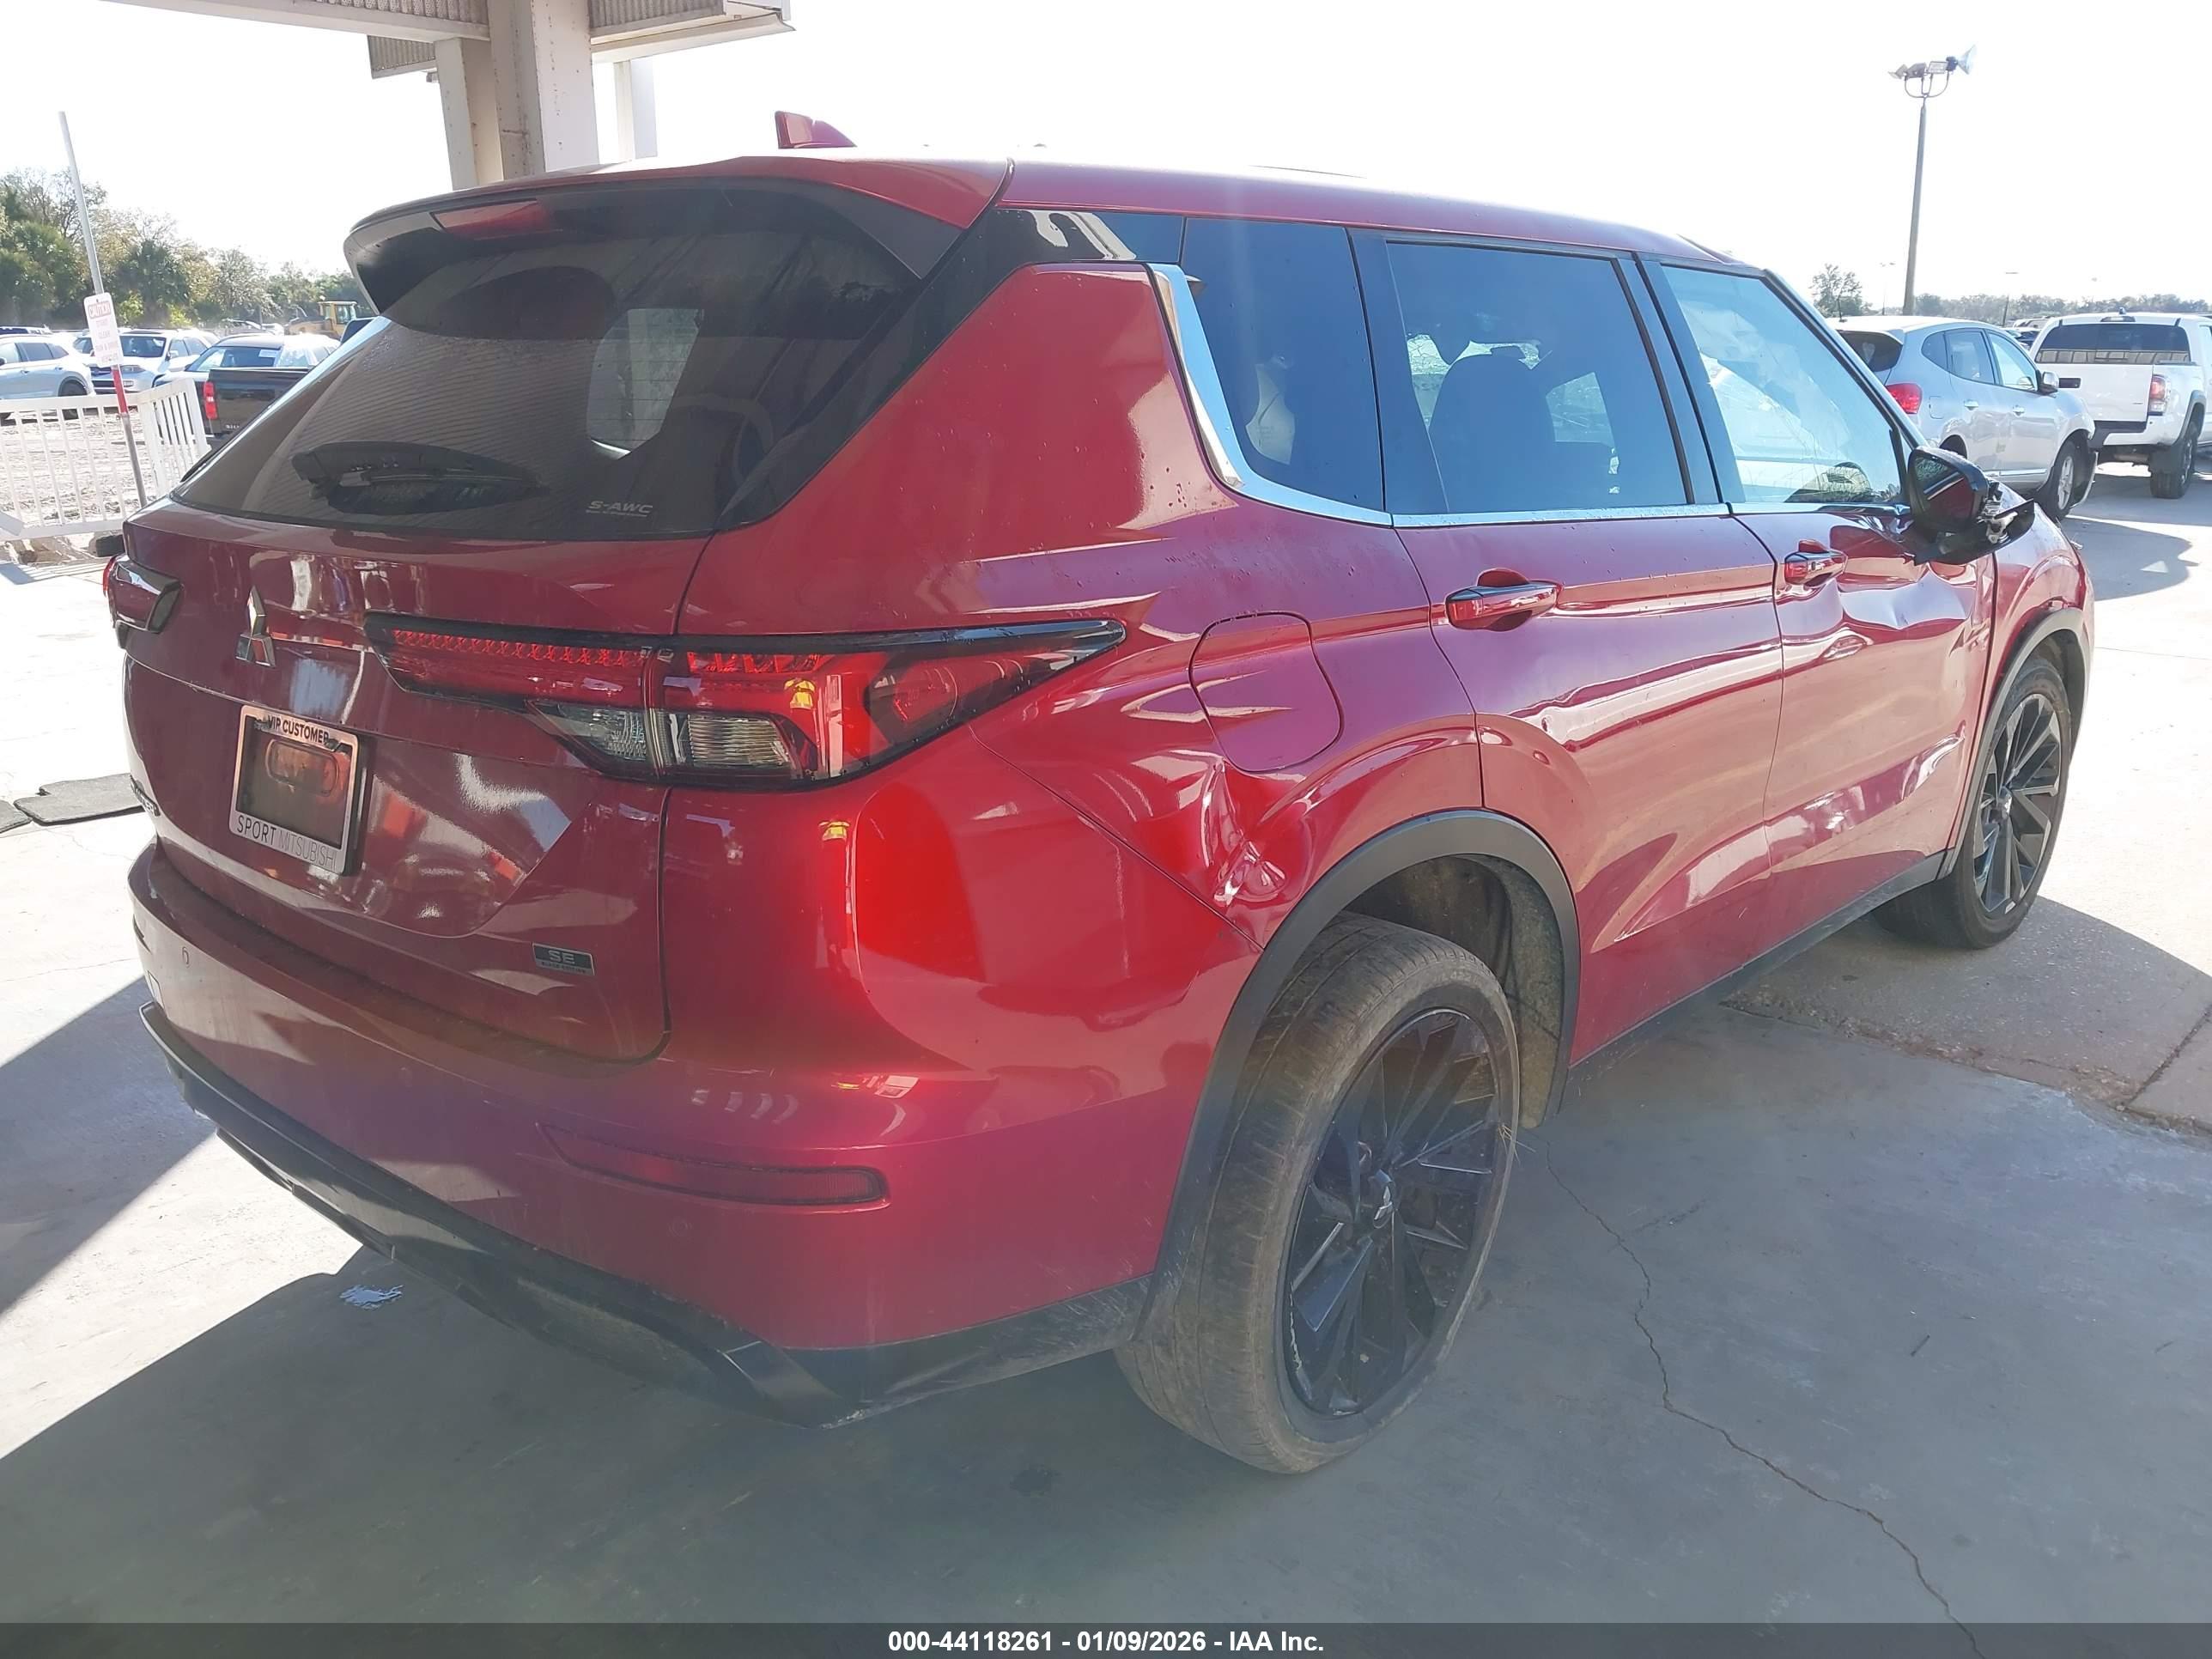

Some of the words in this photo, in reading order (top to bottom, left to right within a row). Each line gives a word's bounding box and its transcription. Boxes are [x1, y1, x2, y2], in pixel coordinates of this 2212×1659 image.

[89, 302, 110, 318] CAUTION
[588, 501, 653, 514] S-AWC
[267, 714, 282, 731] VIP
[282, 720, 330, 744] CUSTOMER
[236, 814, 276, 846] SPORT
[279, 830, 337, 872] MITSUBISHI
[548, 950, 575, 965] SE
